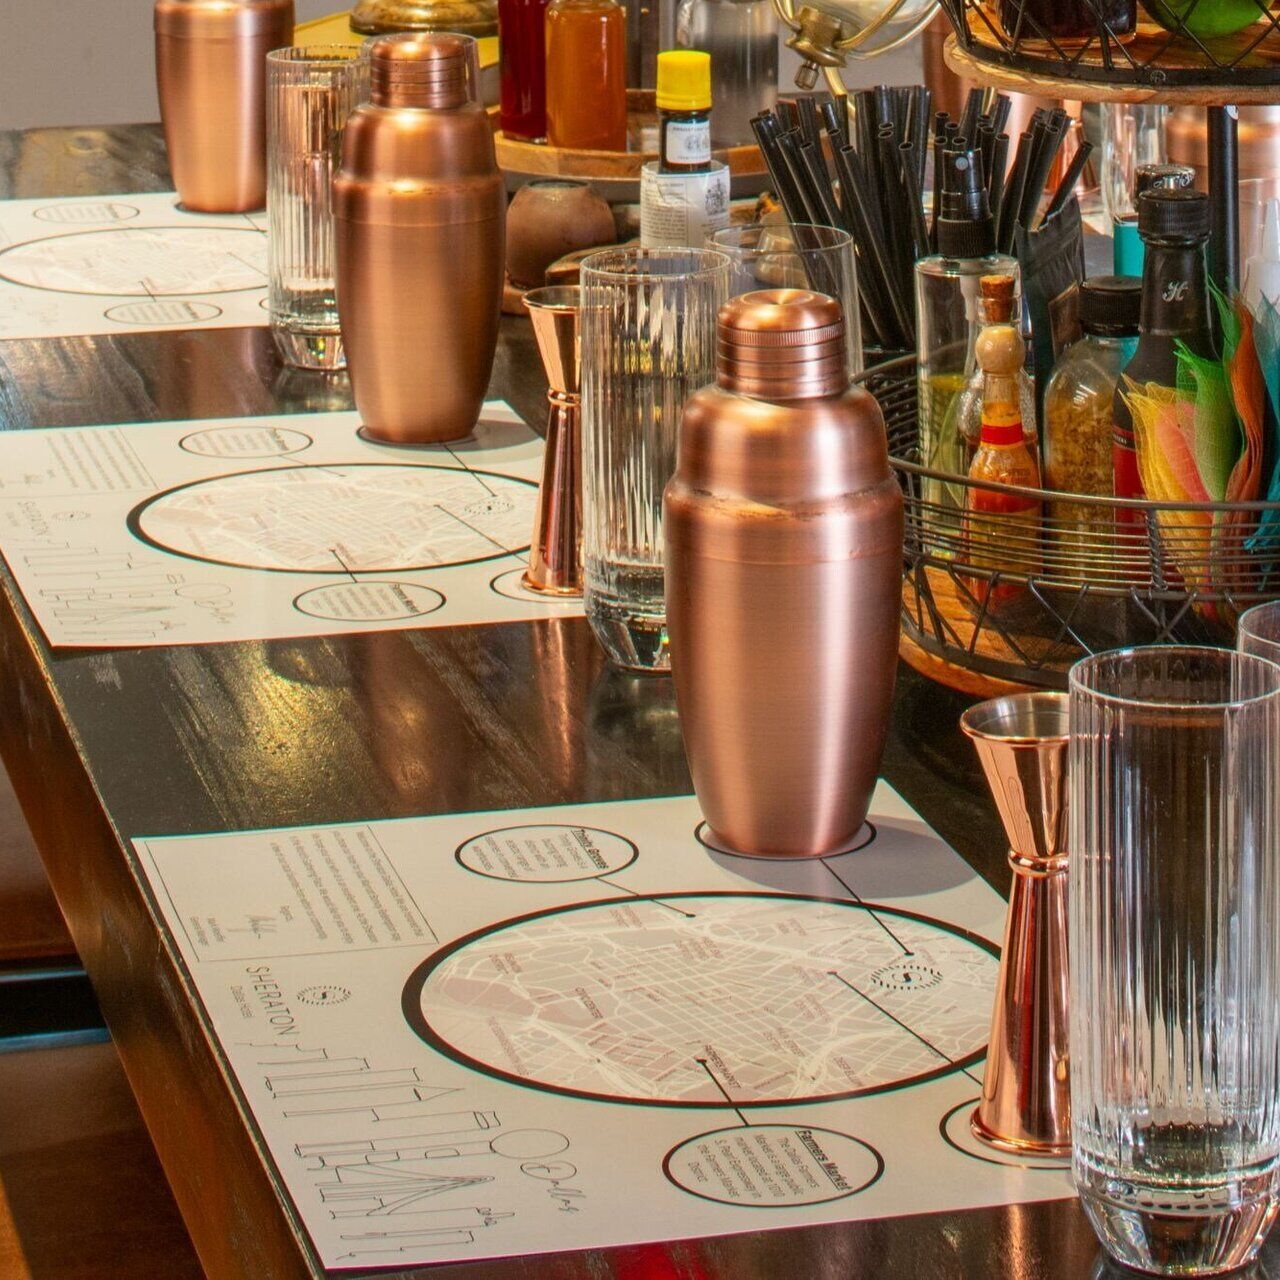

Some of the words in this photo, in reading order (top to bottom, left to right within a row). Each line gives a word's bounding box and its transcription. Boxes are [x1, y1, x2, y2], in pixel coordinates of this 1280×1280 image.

[245, 965, 301, 1036] SHERATON
[520, 1160, 588, 1214] Dallas
[798, 1129, 829, 1162] Farmers
[822, 1162, 853, 1190] Market
